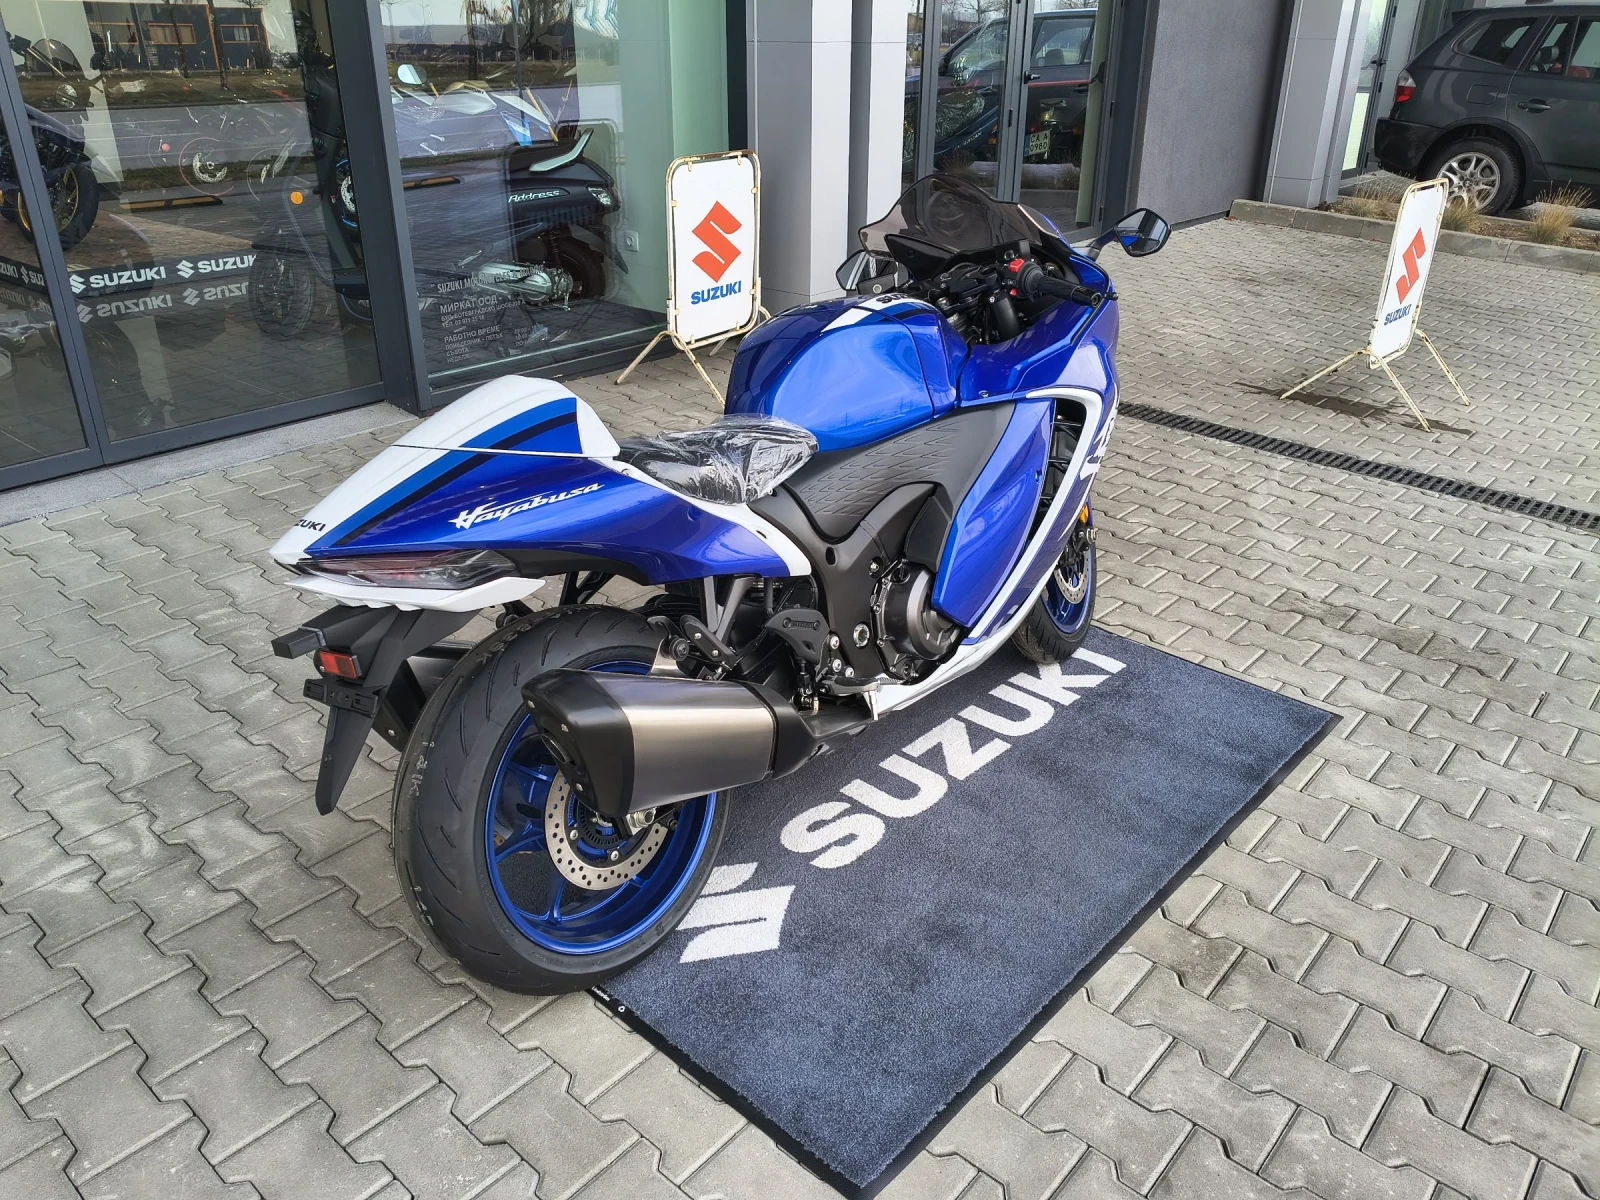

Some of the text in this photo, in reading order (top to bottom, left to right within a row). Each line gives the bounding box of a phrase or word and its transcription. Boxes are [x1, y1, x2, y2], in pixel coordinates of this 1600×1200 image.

[508, 190, 560, 203] Address
[0, 262, 45, 287] ZUKI SUZ
[89, 254, 257, 289] SUZUKI SUZUK
[437, 279, 463, 293] SUZUKI
[690, 280, 742, 305] SUZUKI
[440, 294, 498, 314] МИРКАТ ООД
[1383, 303, 1412, 326] SUZUKI
[444, 325, 500, 343] РАБОТНО ВРЕМЕ
[448, 483, 605, 530] Hayabusa
[293, 518, 327, 532] ZUKI
[780, 647, 1127, 870] SUZUKI
